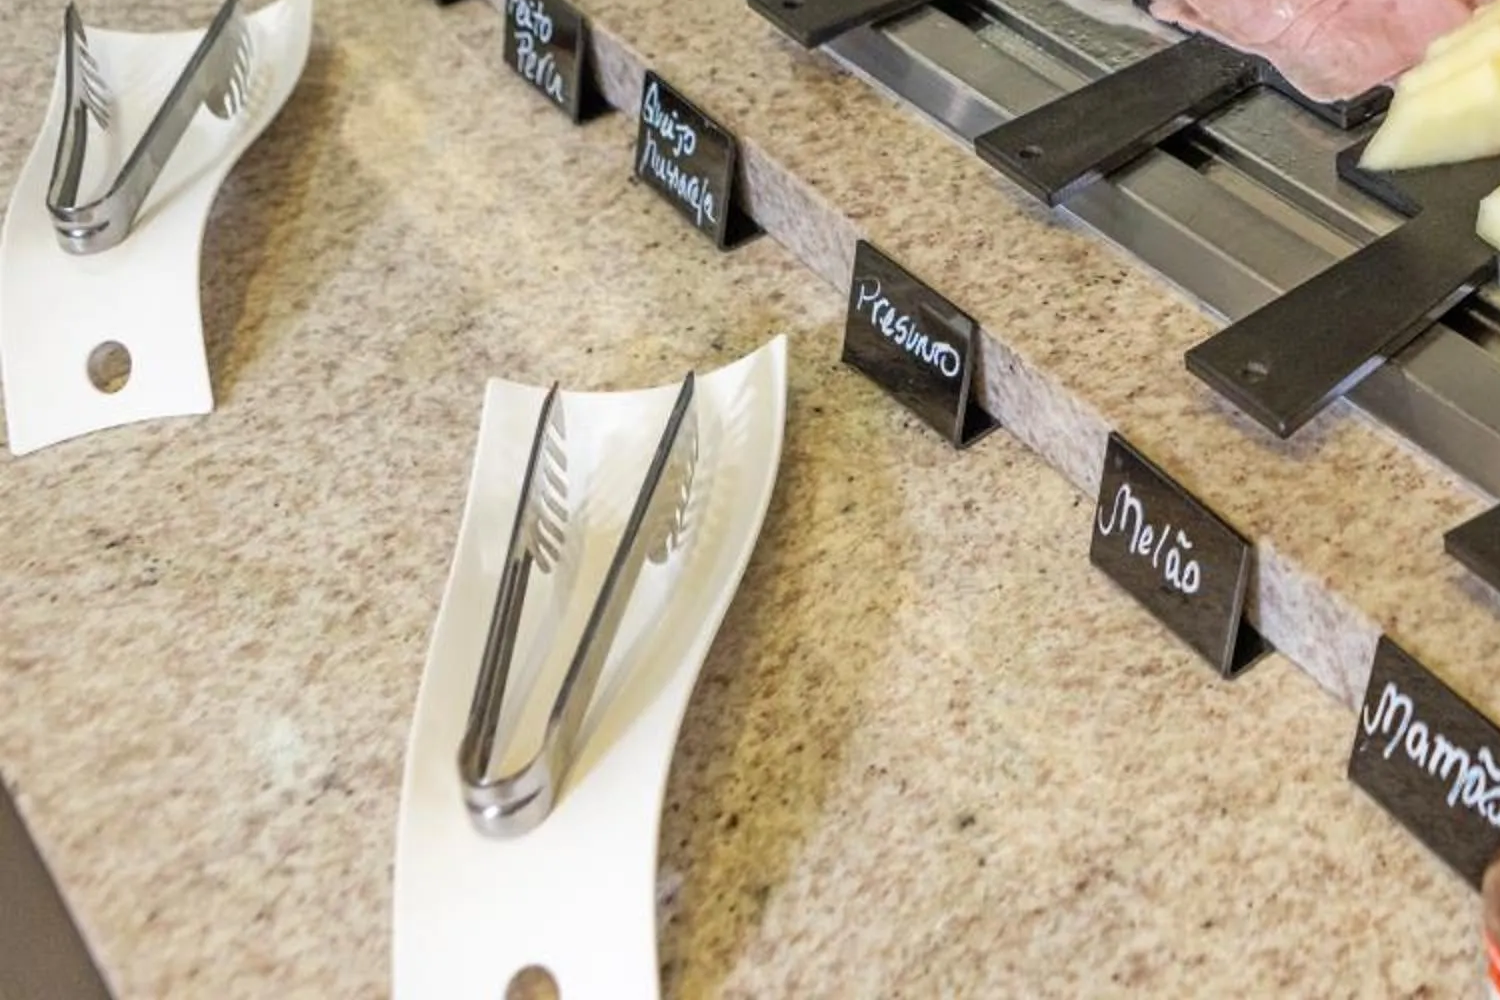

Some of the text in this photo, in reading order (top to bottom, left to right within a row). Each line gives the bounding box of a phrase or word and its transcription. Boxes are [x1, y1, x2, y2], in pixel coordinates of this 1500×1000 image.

[513, 31, 564, 103] Peru
[642, 82, 696, 157] Queijo
[855, 275, 960, 377] Presunto
[1098, 483, 1200, 594] Melão
